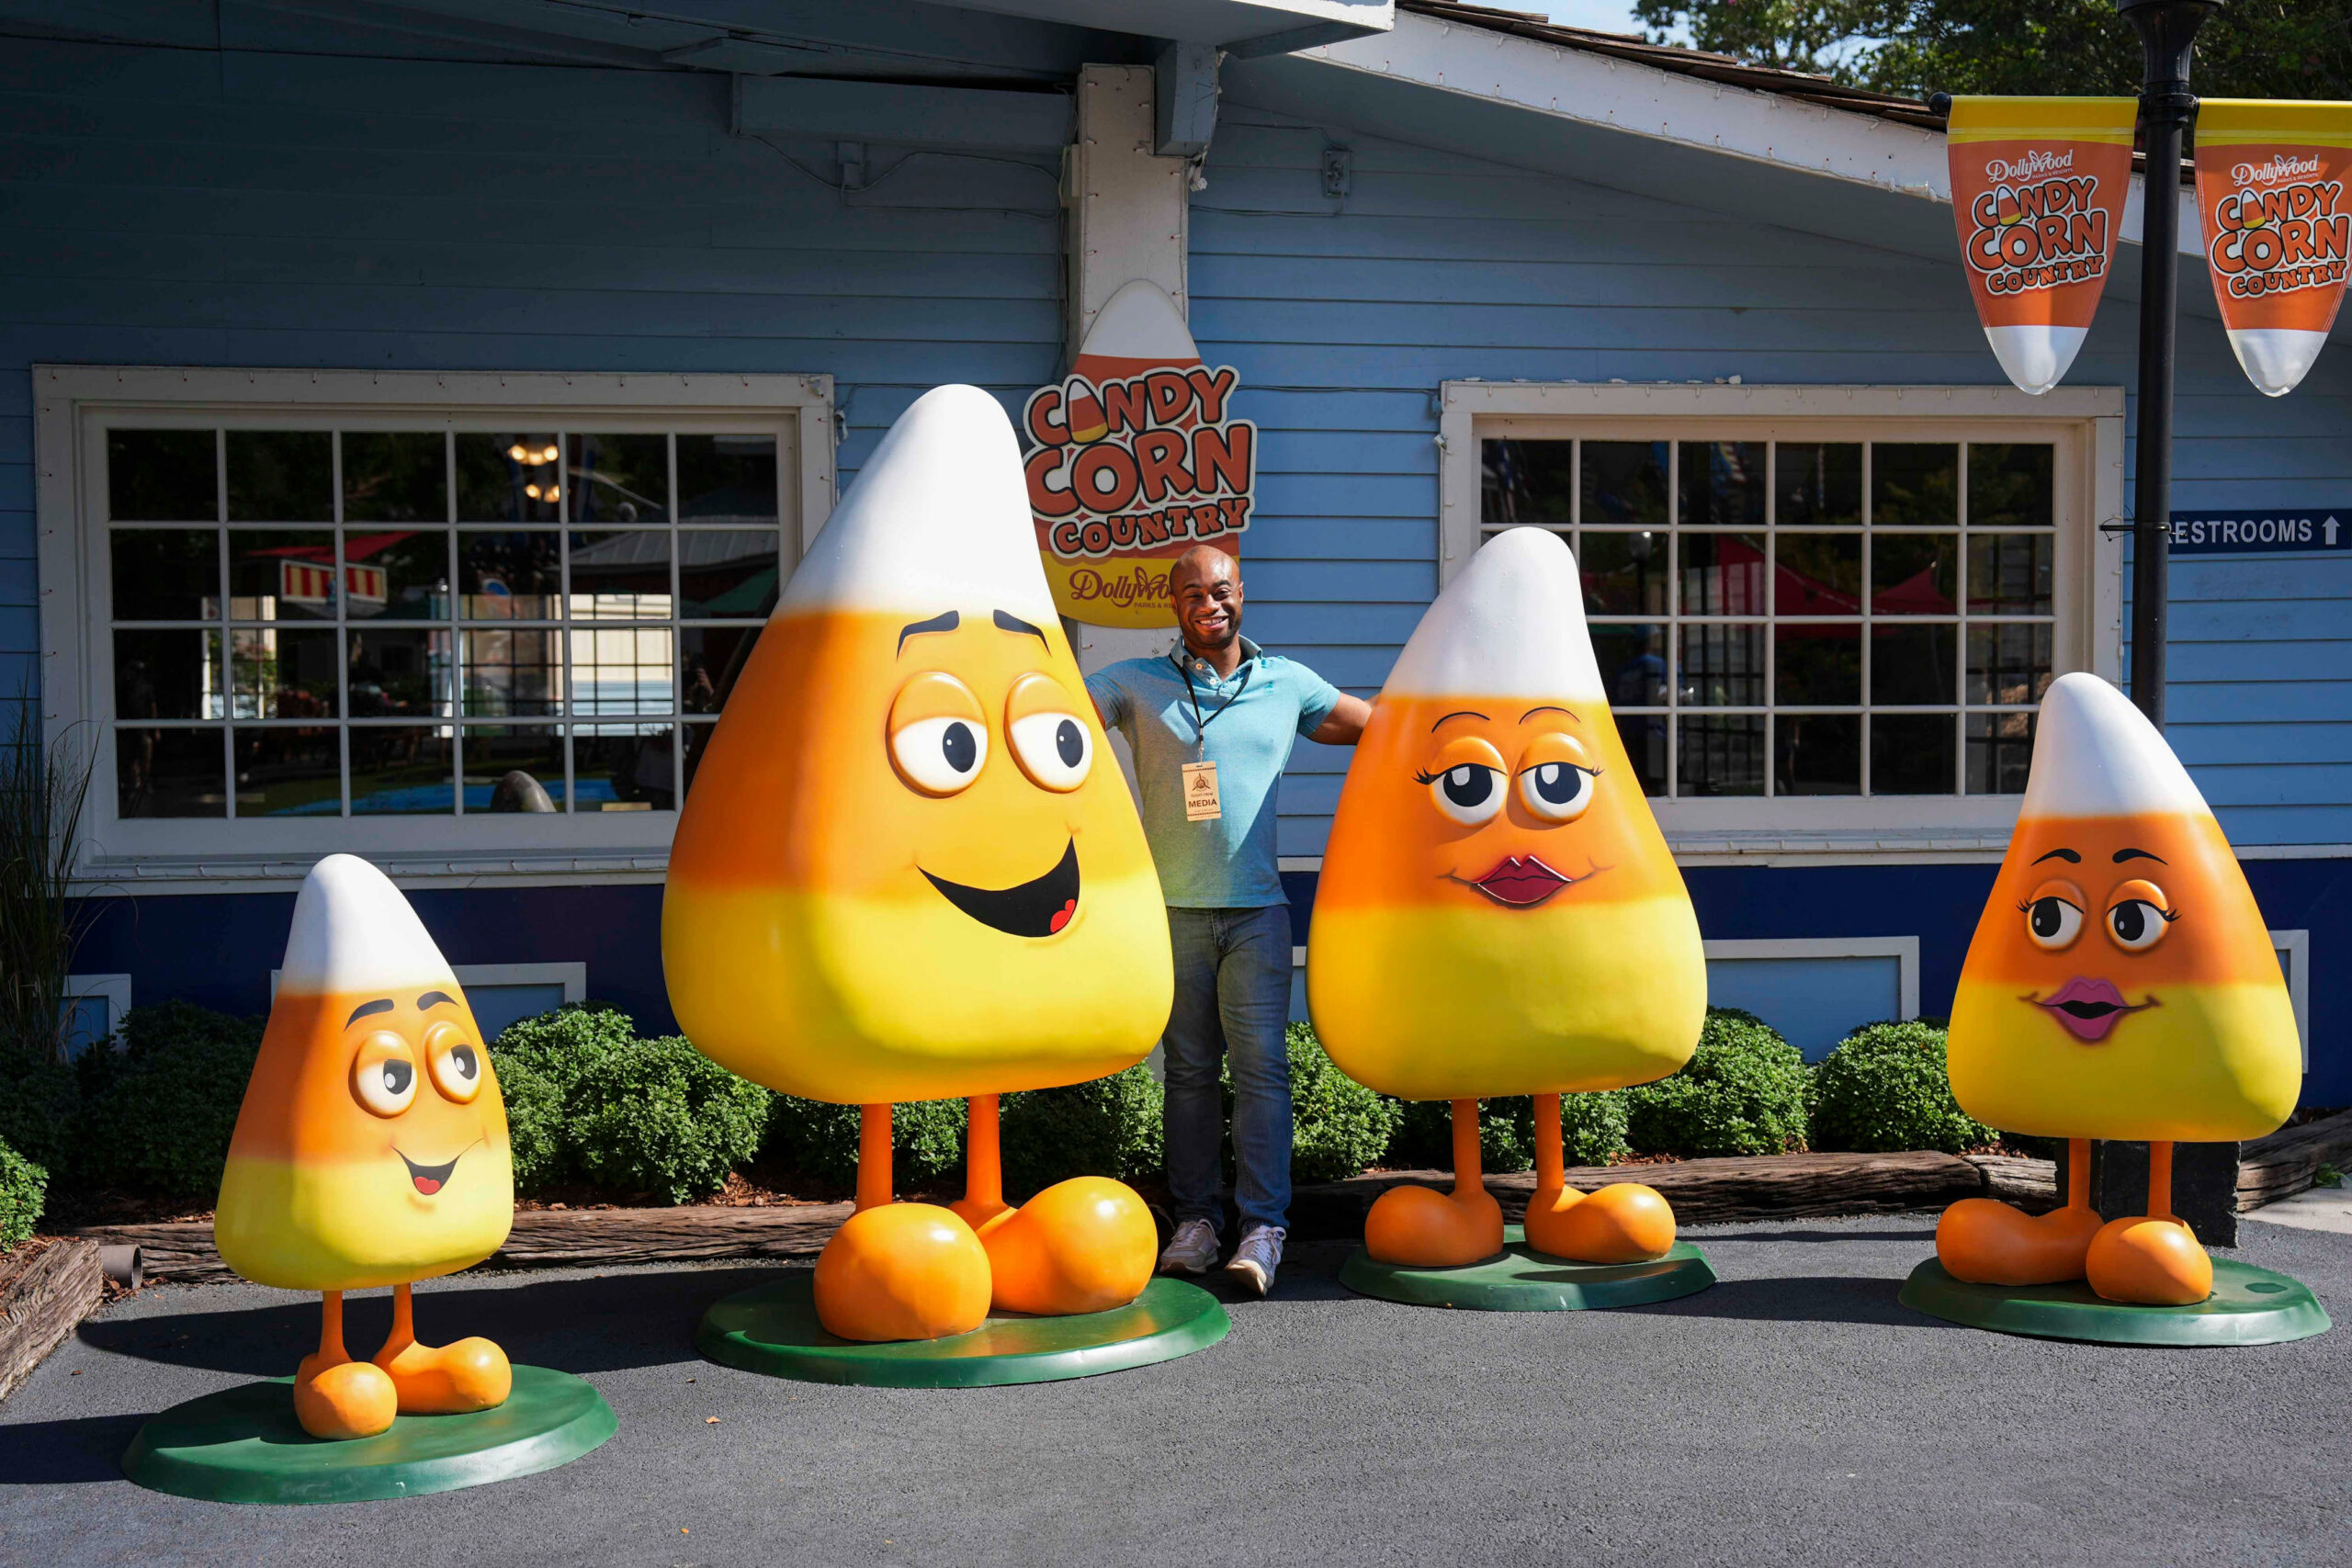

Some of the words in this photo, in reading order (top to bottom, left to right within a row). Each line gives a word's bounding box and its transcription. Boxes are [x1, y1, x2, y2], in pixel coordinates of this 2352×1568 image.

[1970, 211, 2106, 270] CORN
[2212, 216, 2350, 274] CORN
[1988, 255, 2104, 293] COUNTRY
[2231, 261, 2346, 295] COUNTRY
[1023, 423, 1252, 517] CORN
[1054, 497, 1250, 555] COUNTRY
[2168, 519, 2312, 544] ESTROOMS
[1188, 798, 1217, 808] MEDIA
